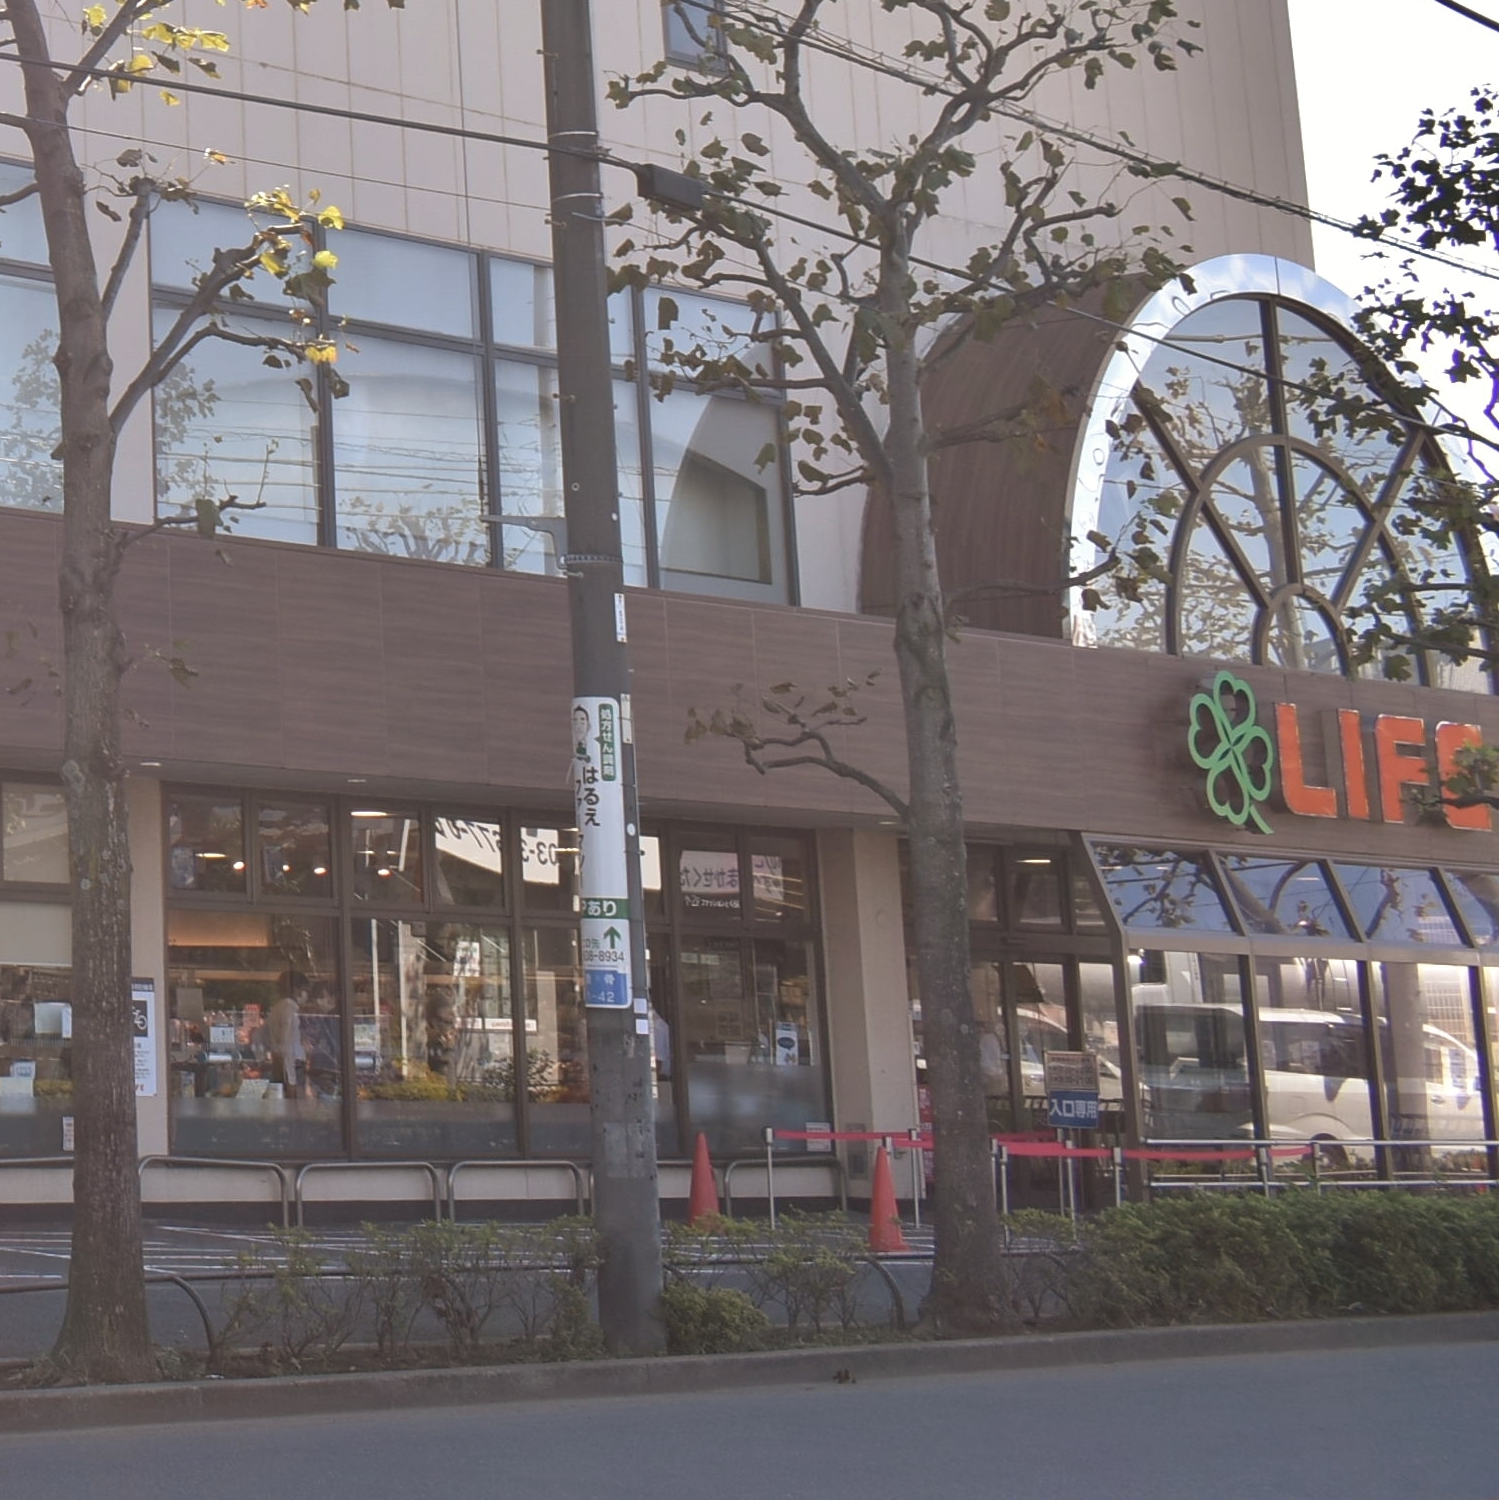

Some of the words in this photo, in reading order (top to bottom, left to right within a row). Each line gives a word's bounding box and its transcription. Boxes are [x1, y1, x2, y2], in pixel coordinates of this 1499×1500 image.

[582, 766, 601, 827] はるえ
[1274, 702, 1493, 832] LIFE
[1049, 1098, 1098, 1119] 入口専用
